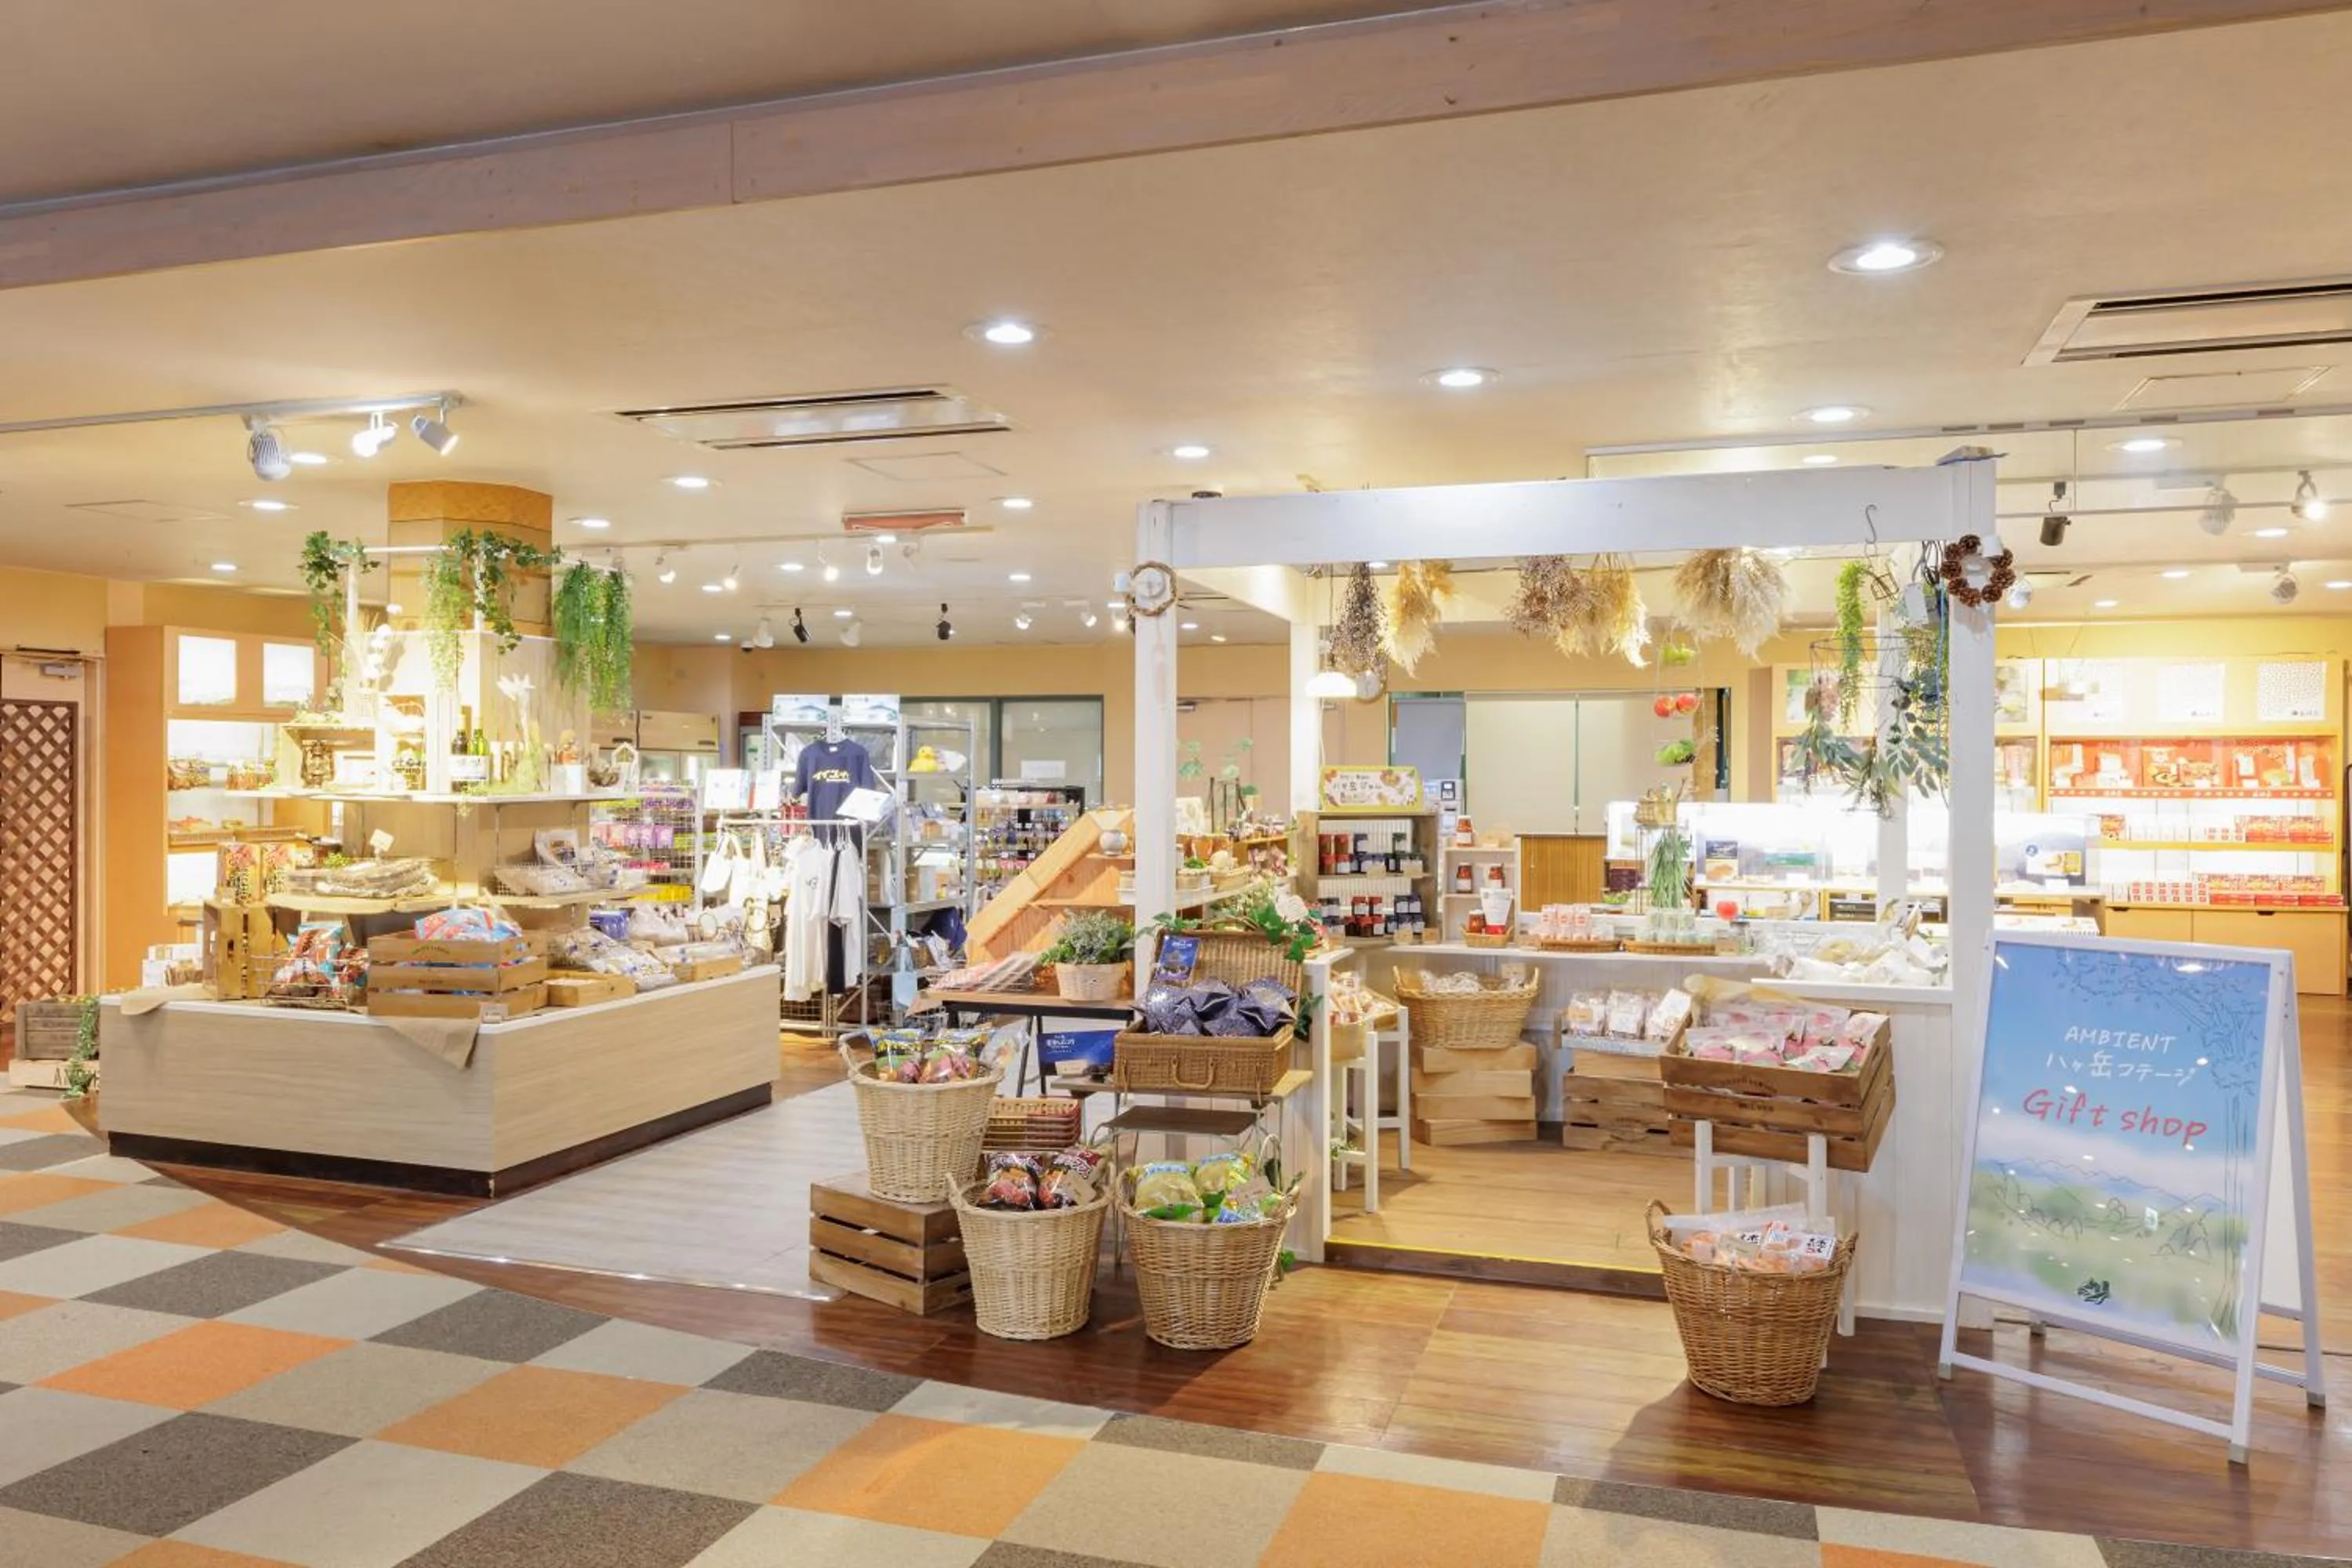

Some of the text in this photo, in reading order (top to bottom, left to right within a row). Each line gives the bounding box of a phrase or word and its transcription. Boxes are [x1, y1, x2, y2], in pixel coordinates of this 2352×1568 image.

[2064, 1025, 2176, 1054] AMBIENT
[2023, 1088, 2209, 1147] Gift shop
